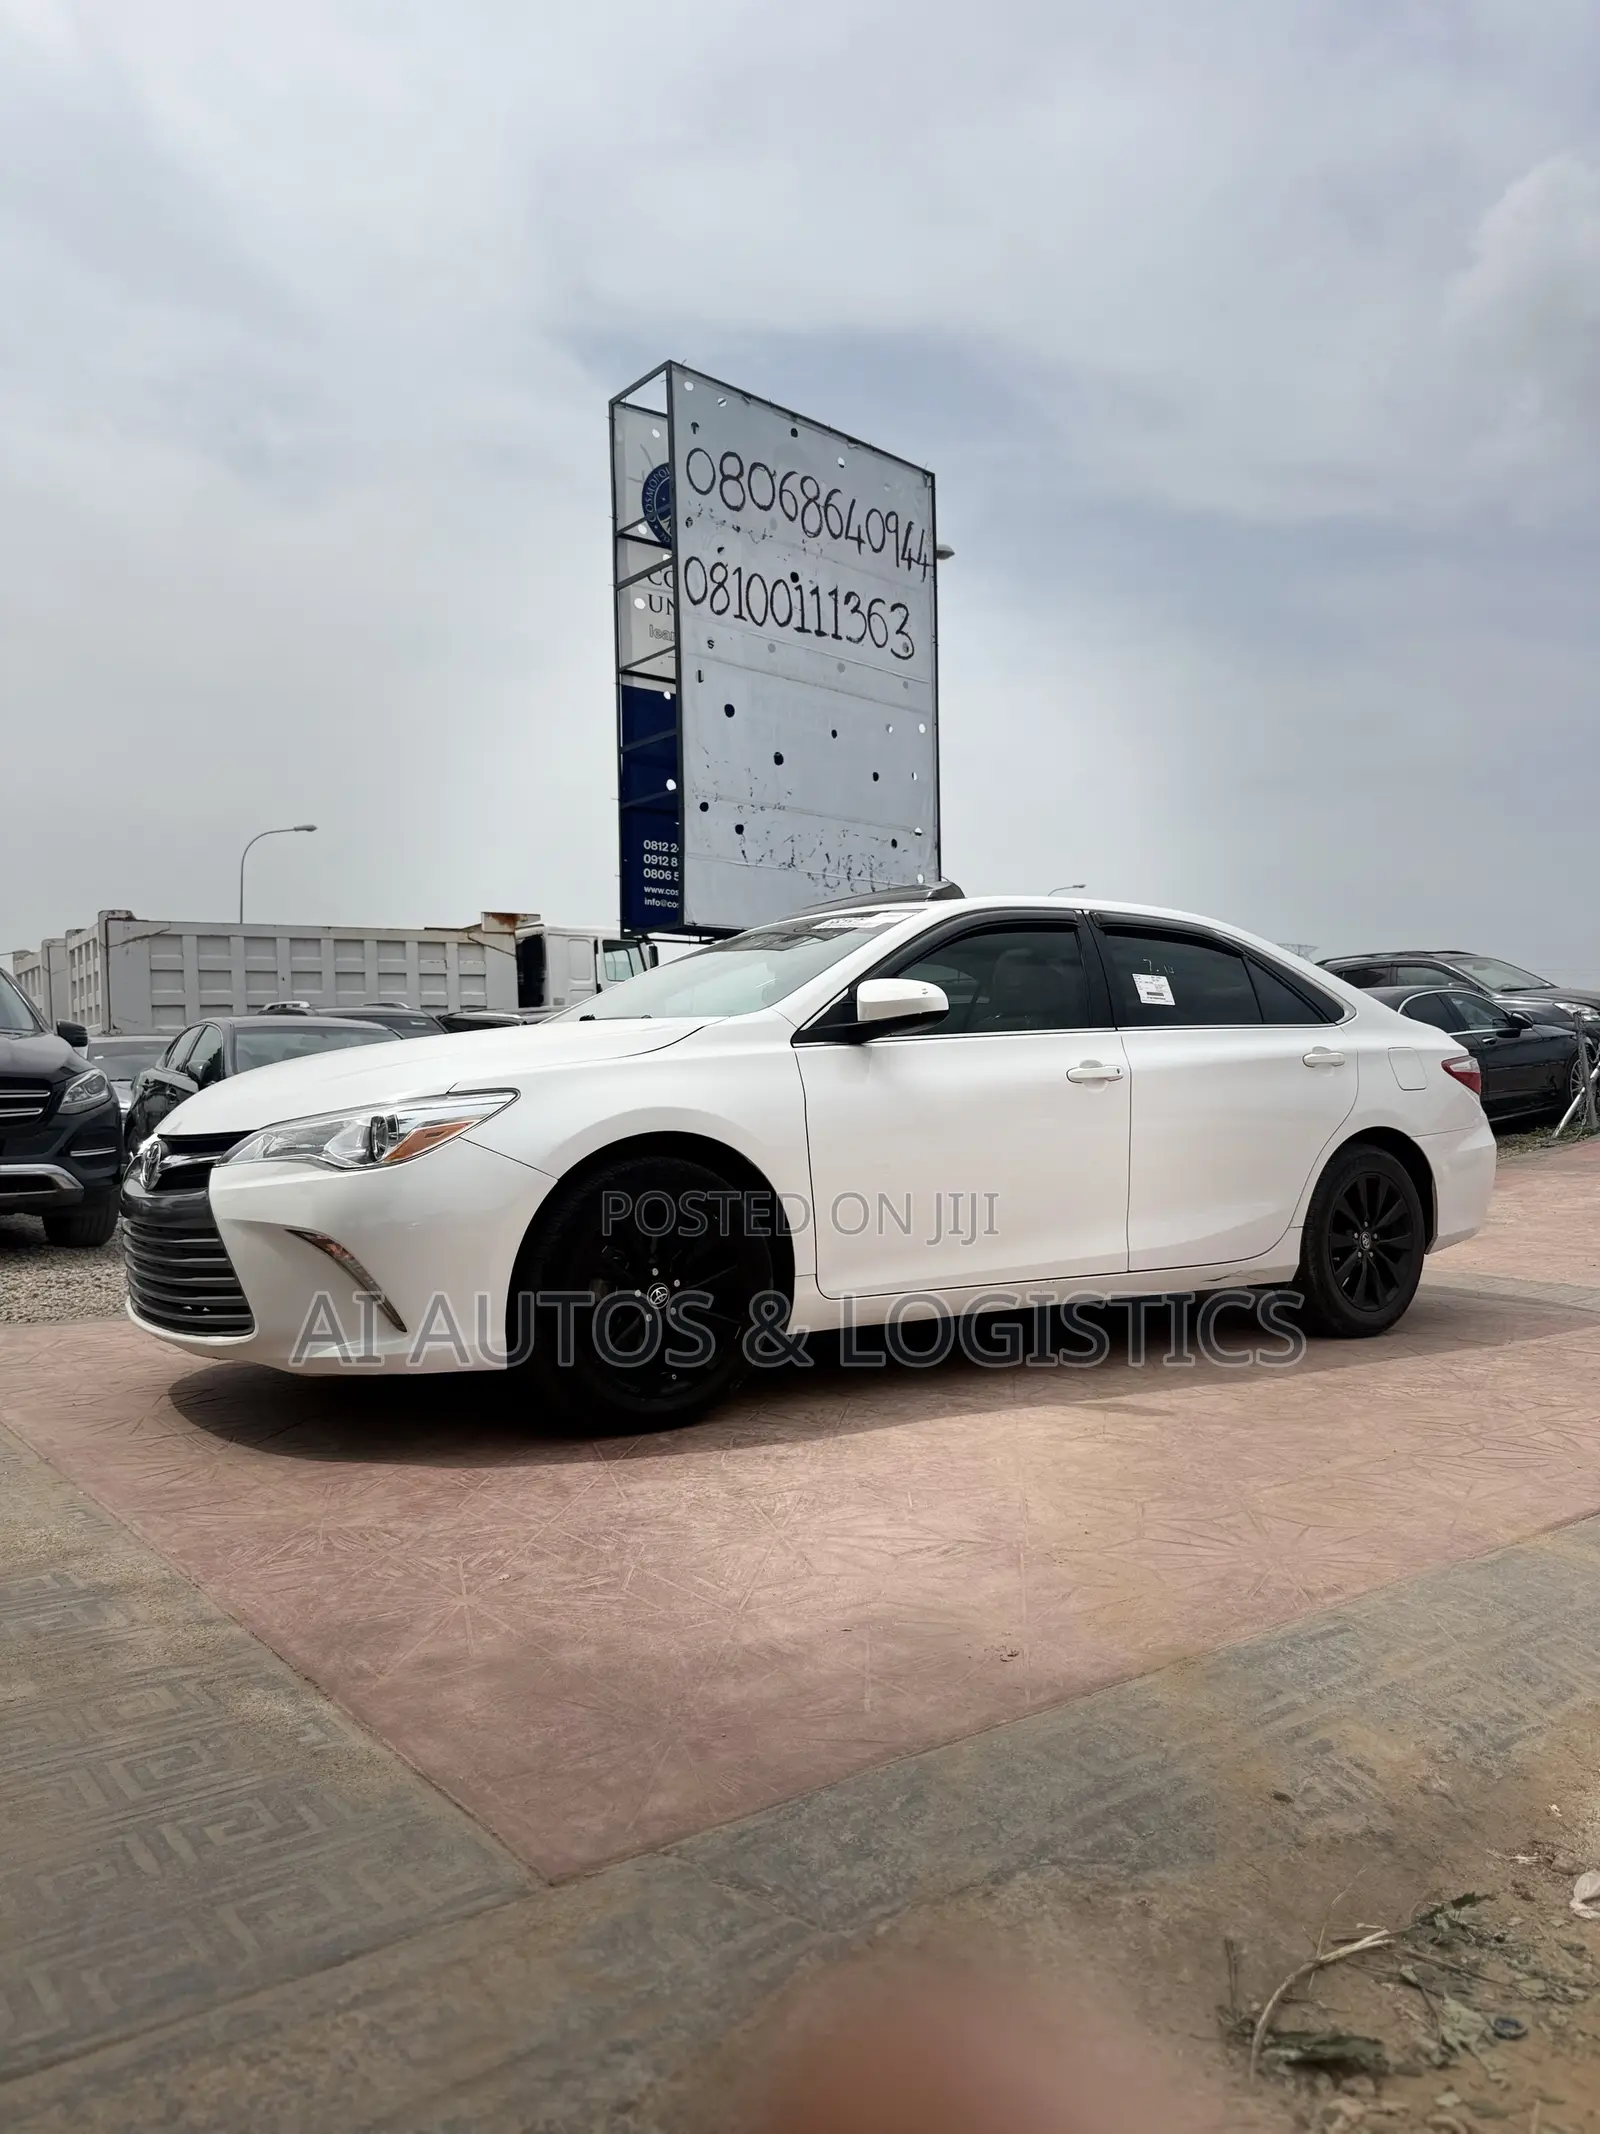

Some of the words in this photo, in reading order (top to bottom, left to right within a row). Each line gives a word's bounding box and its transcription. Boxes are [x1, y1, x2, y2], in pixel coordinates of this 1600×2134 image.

[686, 448, 933, 583] 08068640944
[684, 556, 915, 660] 08100111363
[643, 840, 669, 852] 0812
[670, 843, 679, 853] 2
[643, 854, 669, 866] 0912
[643, 868, 672, 880] 0806
